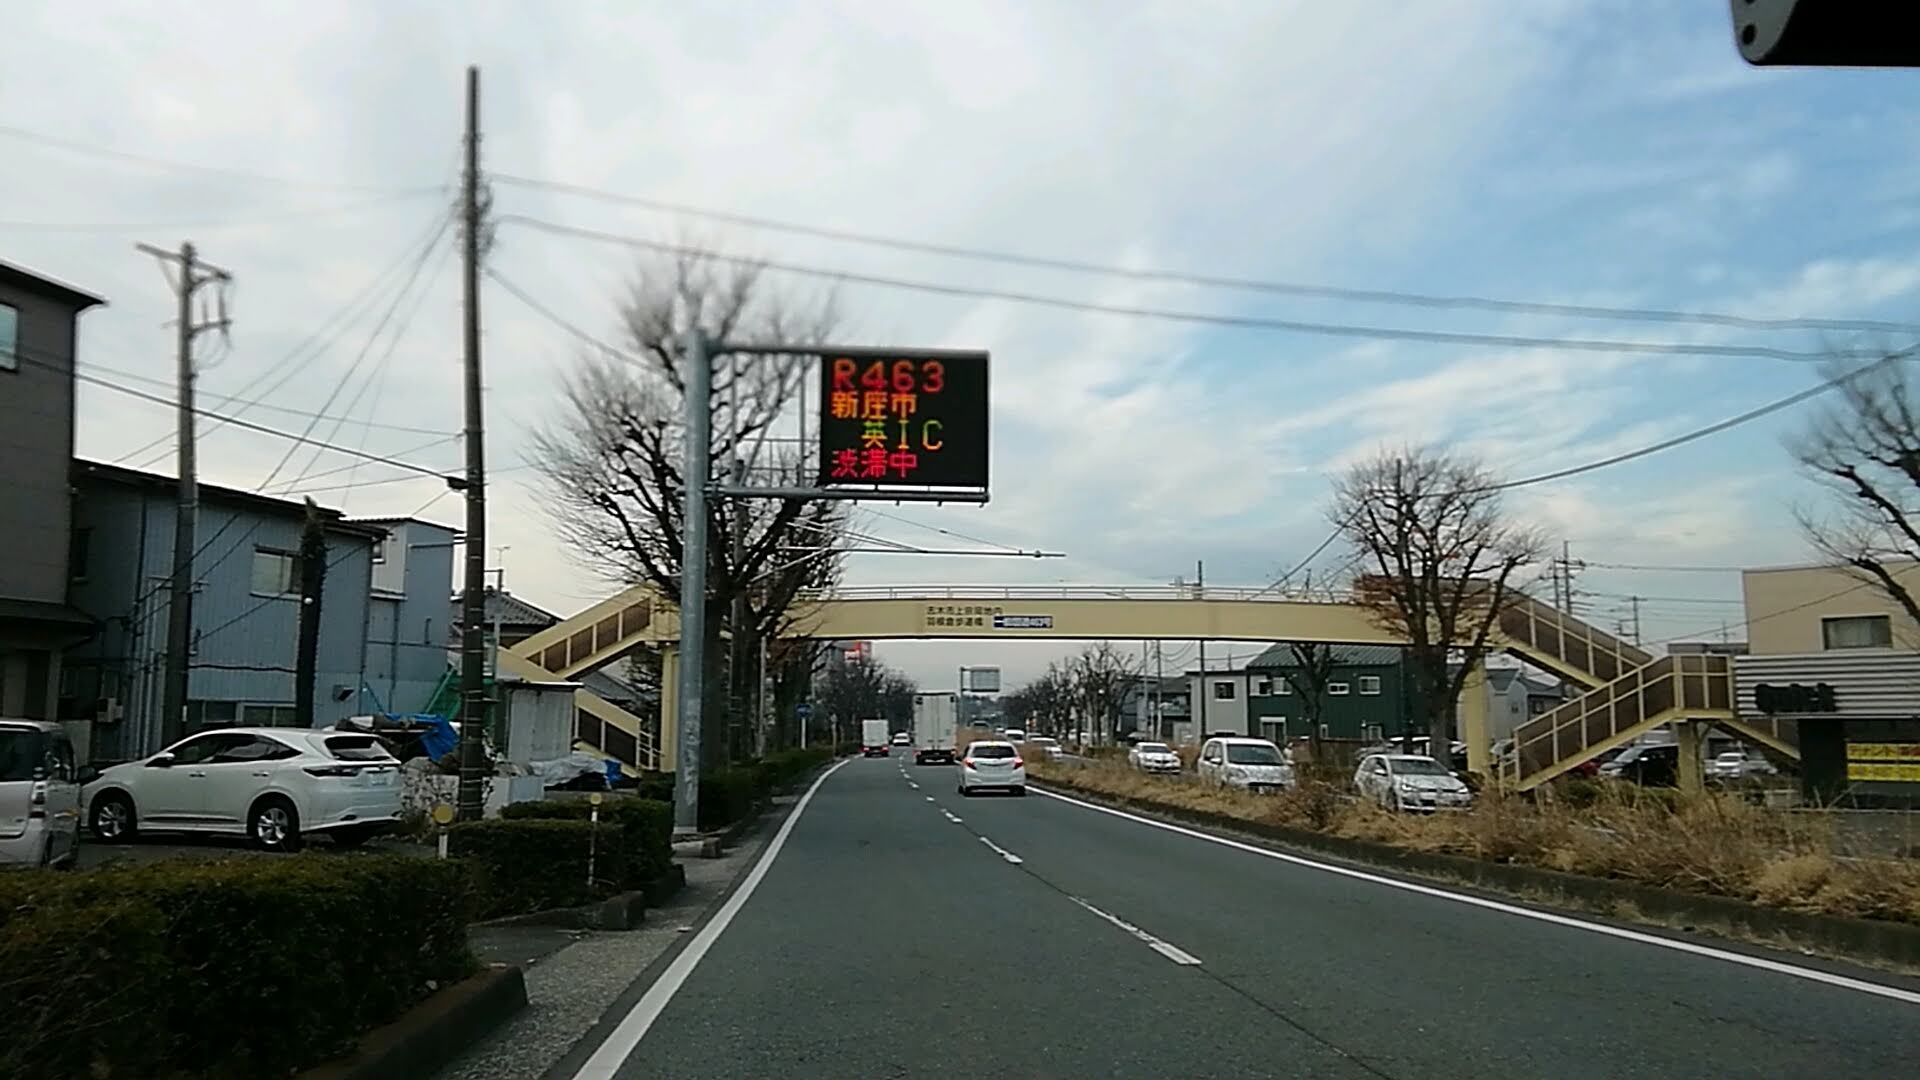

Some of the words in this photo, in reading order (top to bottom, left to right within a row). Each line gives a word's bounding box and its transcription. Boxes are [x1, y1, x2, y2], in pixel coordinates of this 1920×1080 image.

[833, 358, 944, 392] R463
[831, 391, 917, 419] 新座市
[831, 449, 917, 478] 渋滞中
